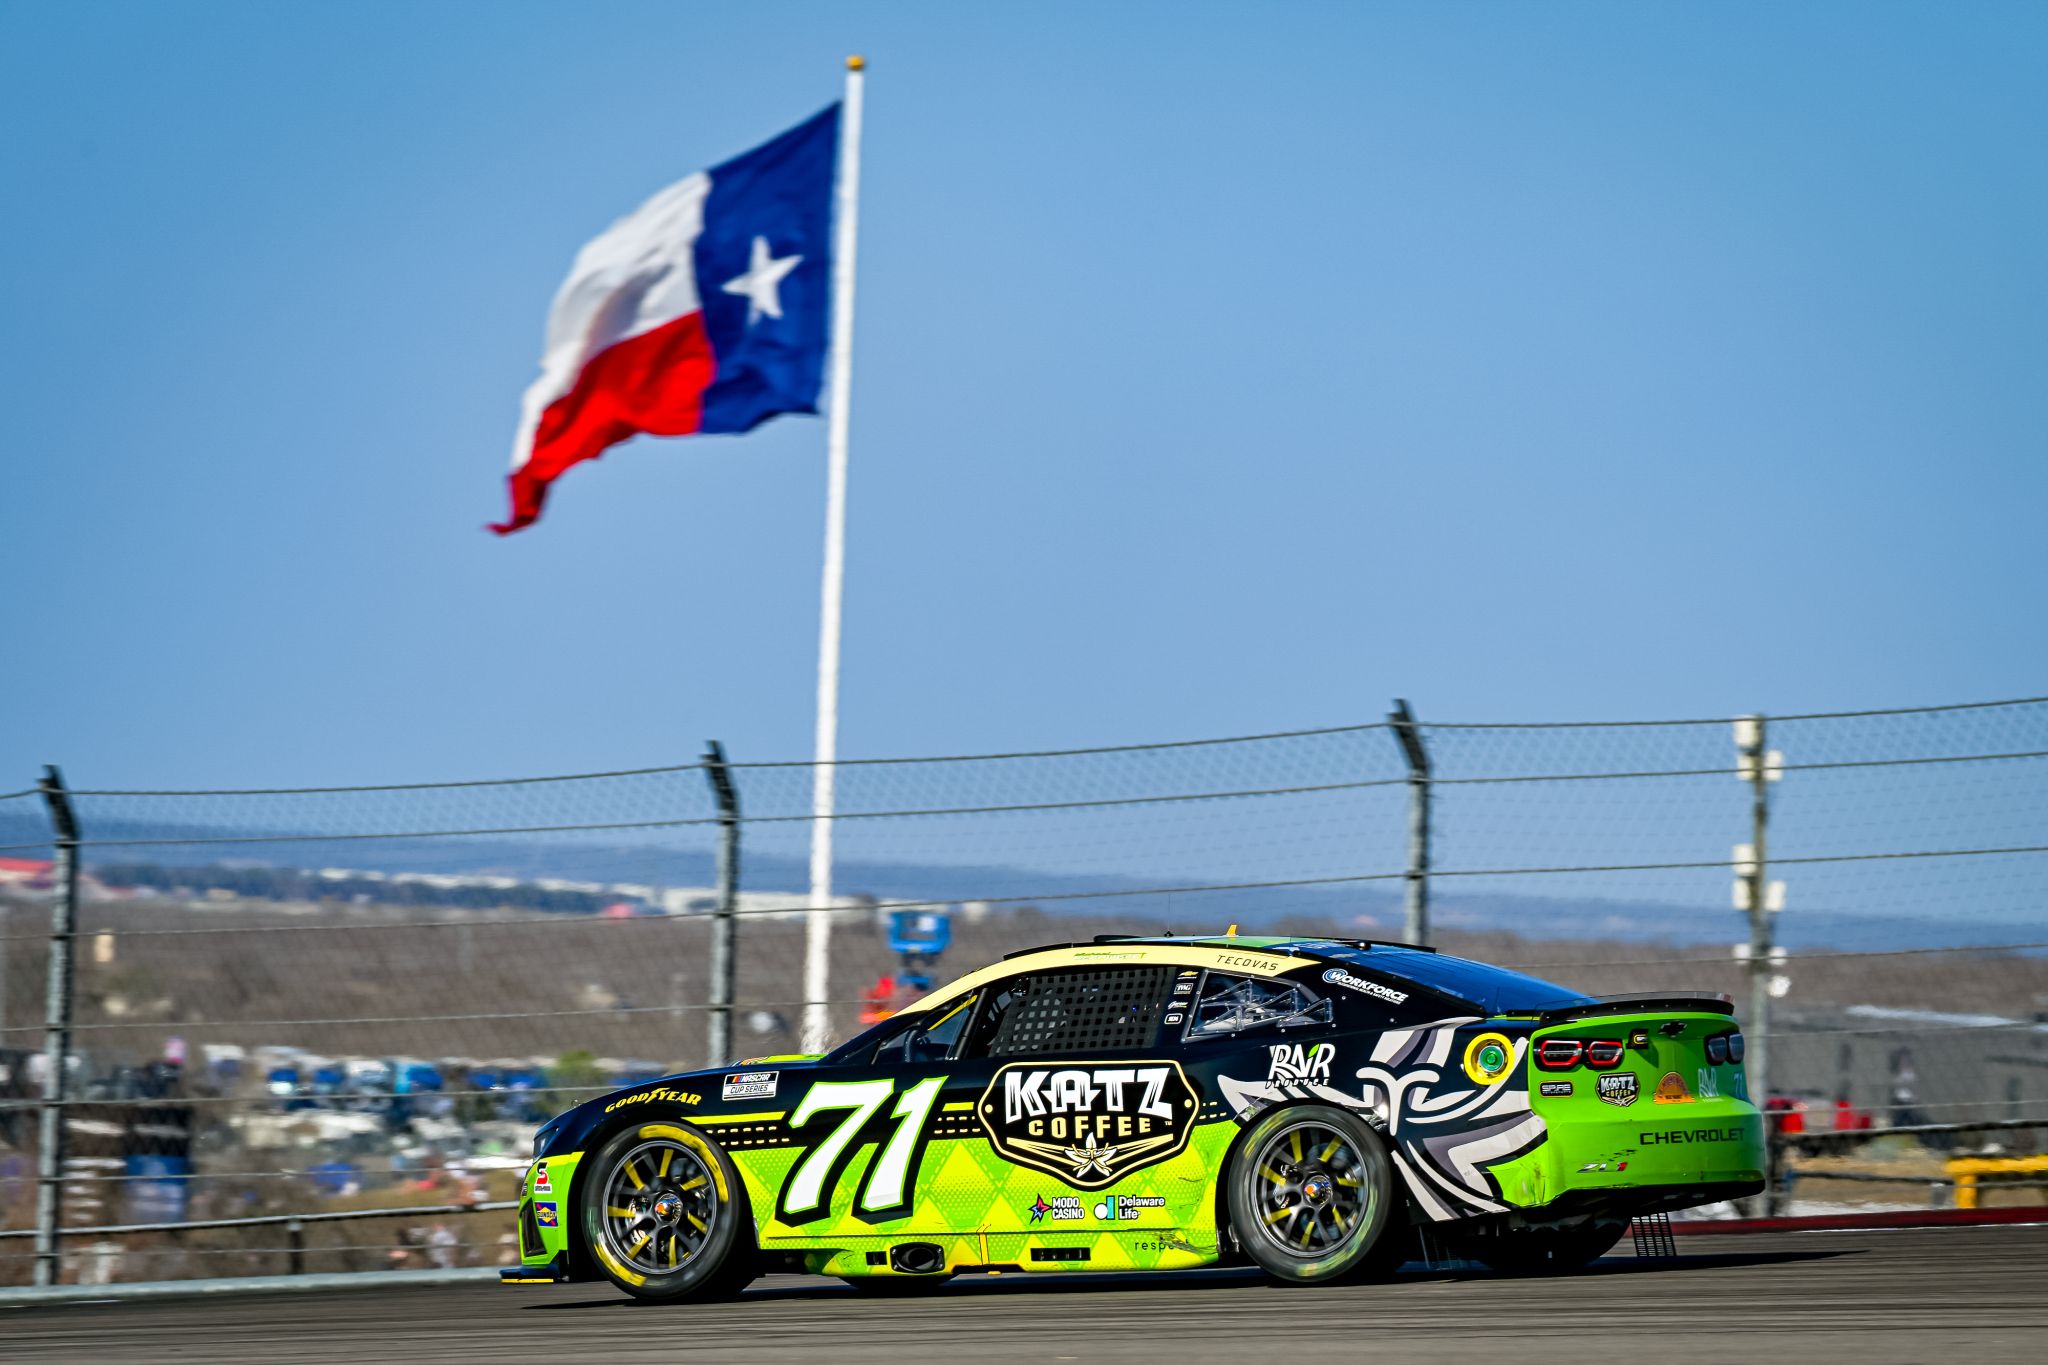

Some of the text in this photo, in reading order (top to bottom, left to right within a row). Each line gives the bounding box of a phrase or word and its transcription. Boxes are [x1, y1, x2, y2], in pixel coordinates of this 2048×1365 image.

[1217, 954, 1279, 971] TECOVAS
[1329, 971, 1409, 1002] WORKFORCE
[740, 1073, 772, 1083] NASCAR
[1600, 1076, 1636, 1093] KATZ
[730, 1084, 769, 1094] CUP SERIES
[1004, 1067, 1174, 1125] KATZ
[604, 1087, 702, 1113] GOODYEAR
[1028, 1115, 1151, 1139] COFFEE
[783, 1075, 950, 1215] 71
[1639, 1128, 1745, 1146] CHEVROLET
[1052, 1197, 1080, 1208] MODO
[1118, 1195, 1165, 1207] Delaware
[1052, 1208, 1085, 1220] CASINO
[1118, 1208, 1139, 1220] Life
